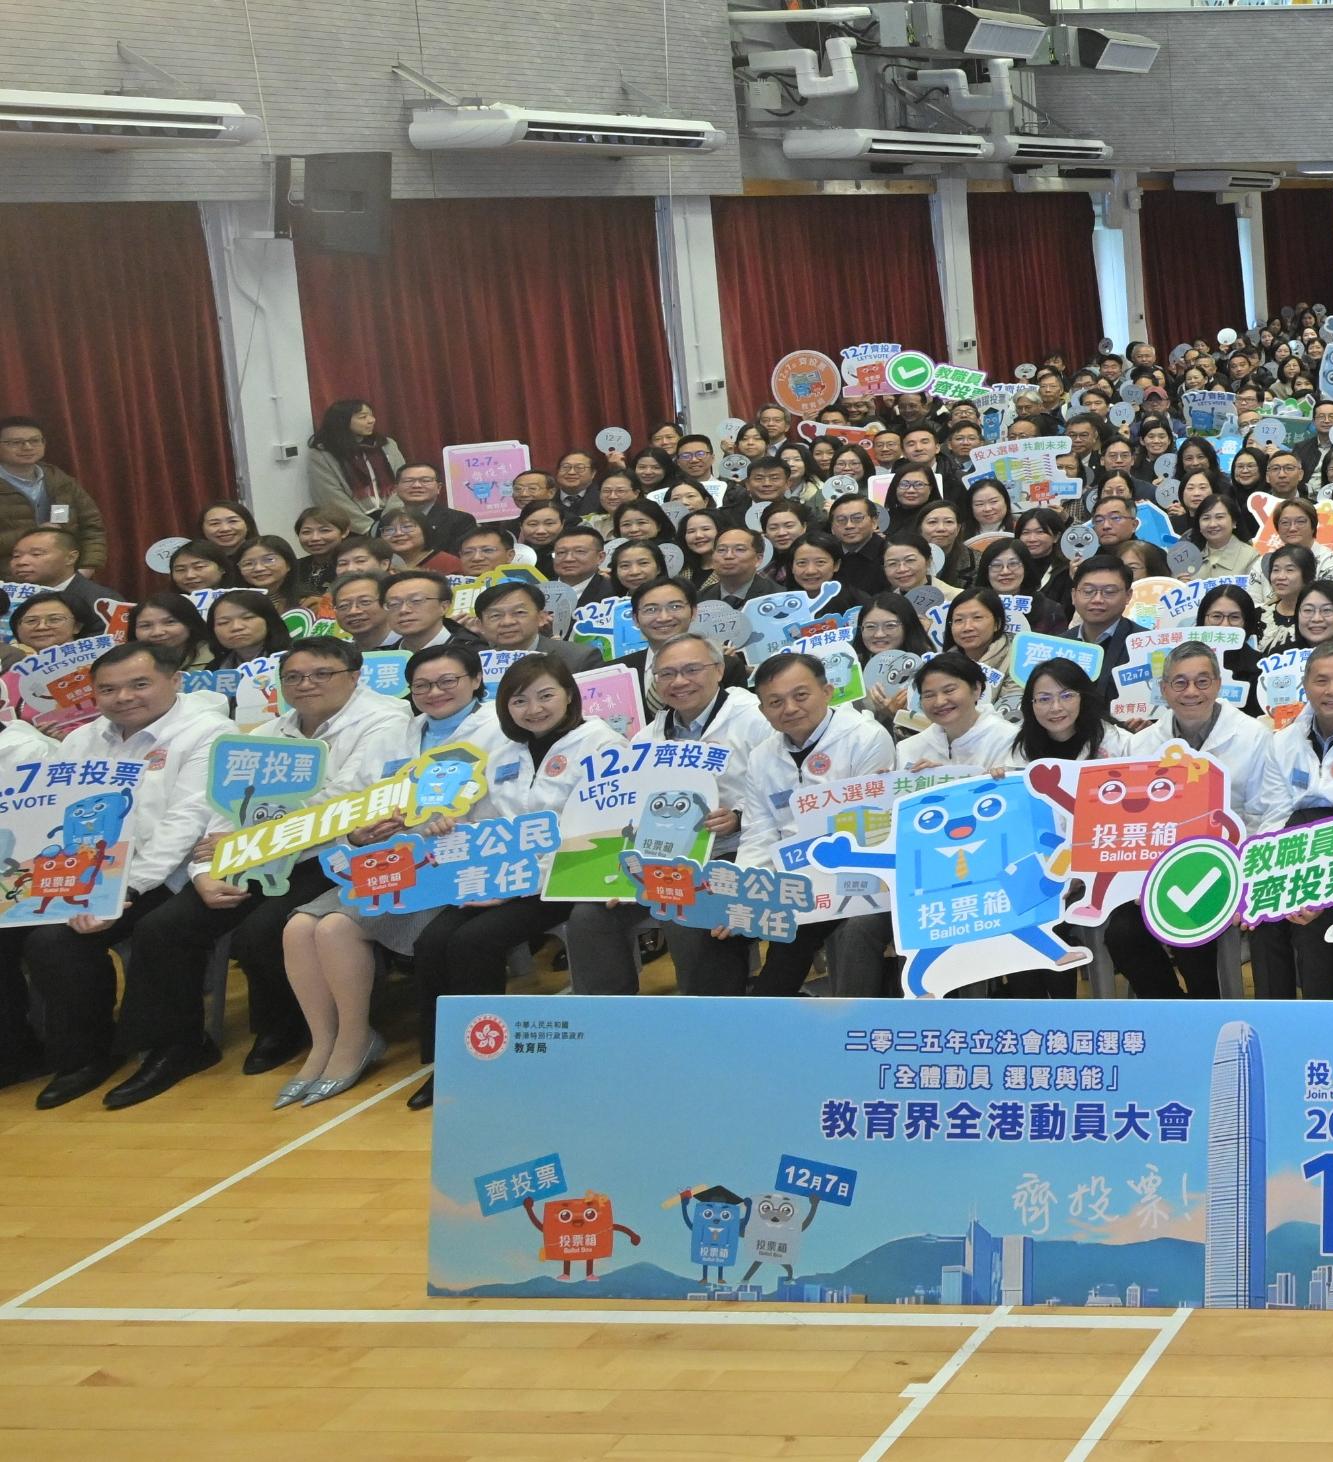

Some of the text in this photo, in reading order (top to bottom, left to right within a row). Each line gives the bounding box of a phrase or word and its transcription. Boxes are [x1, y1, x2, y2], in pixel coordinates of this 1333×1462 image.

[843, 344, 901, 359] 12.7 齊投票
[935, 365, 985, 383] 教職員
[974, 438, 1067, 462] 投入選舉 共創未來
[1130, 631, 1240, 649] 投入選舉 共創未來
[12, 636, 112, 676] 12.7 齊投票
[1260, 651, 1298, 674] 12.7
[1120, 668, 1150, 684] 12月7日
[1114, 702, 1148, 716] 教育局
[47, 761, 144, 786] 齊投票
[226, 749, 314, 786] 齊投票
[580, 743, 731, 782] 12.7 齊投票
[595, 791, 637, 811] VOTE
[798, 780, 885, 814] 投入選舉
[220, 780, 408, 873] 以身作則
[1091, 821, 1178, 849] 投票箱
[433, 818, 555, 864] 盡公民
[454, 861, 533, 899] 責任
[708, 868, 808, 907] 盡公民
[726, 904, 794, 936] 責任
[917, 888, 1012, 930] 投票箱
[929, 917, 1002, 941] Ballot Box
[514, 1020, 569, 1029] 中華人民共和國
[514, 1031, 584, 1040] 香港特別行政區政府
[514, 1042, 547, 1054] 教育局
[844, 1029, 1146, 1056] 二零二五年立法會換屆選舉
[878, 1064, 1120, 1092] 「全體動員 選賢與能」
[1306, 1090, 1328, 1099] Join
[821, 1100, 1194, 1143] 教育界全港動員大會
[485, 1161, 560, 1206] 齊投票
[784, 1166, 849, 1197] 12月7日
